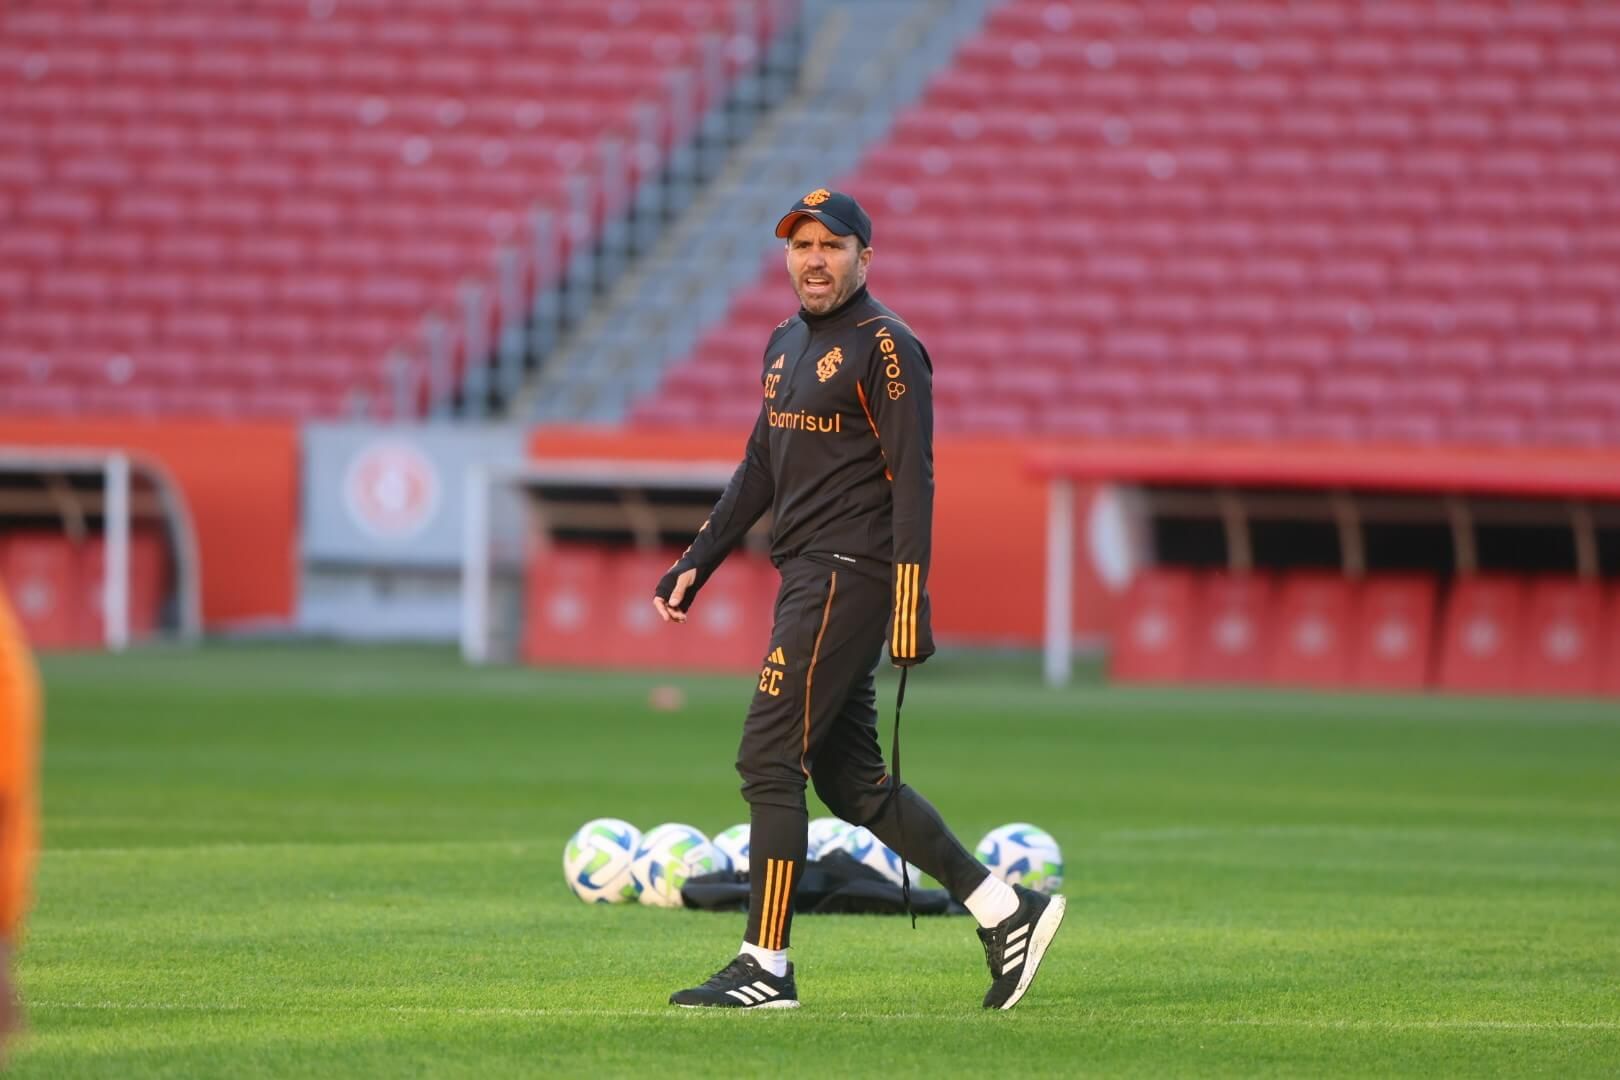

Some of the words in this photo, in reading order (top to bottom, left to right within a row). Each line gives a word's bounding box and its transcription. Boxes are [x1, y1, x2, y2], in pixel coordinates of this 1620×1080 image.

[875, 326, 899, 379] vero
[768, 405, 840, 433] banrisul
[759, 666, 784, 696] EC
